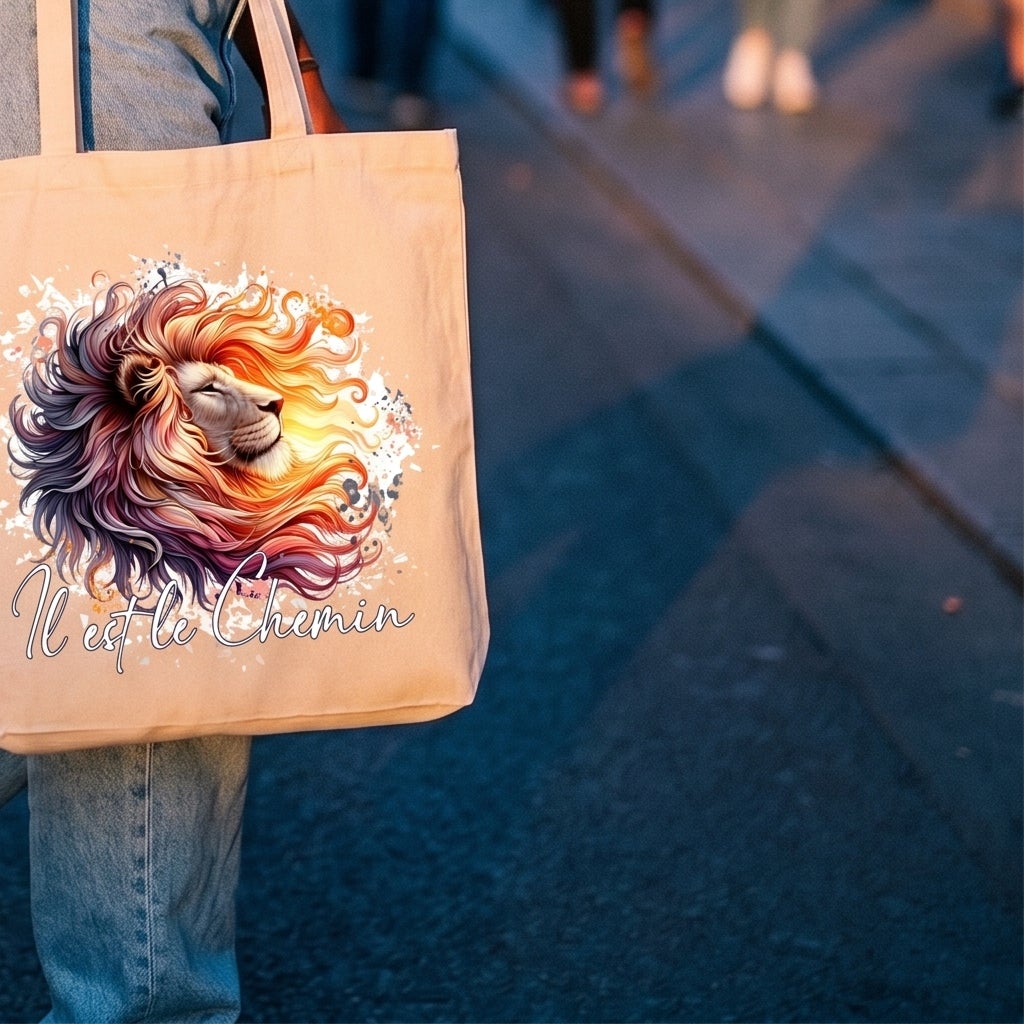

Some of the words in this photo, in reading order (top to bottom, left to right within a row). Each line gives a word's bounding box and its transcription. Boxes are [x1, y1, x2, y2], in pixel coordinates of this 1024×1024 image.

[12, 563, 69, 660] Il
[83, 595, 156, 674] est
[151, 579, 197, 650] le
[211, 551, 415, 648] Chemin
